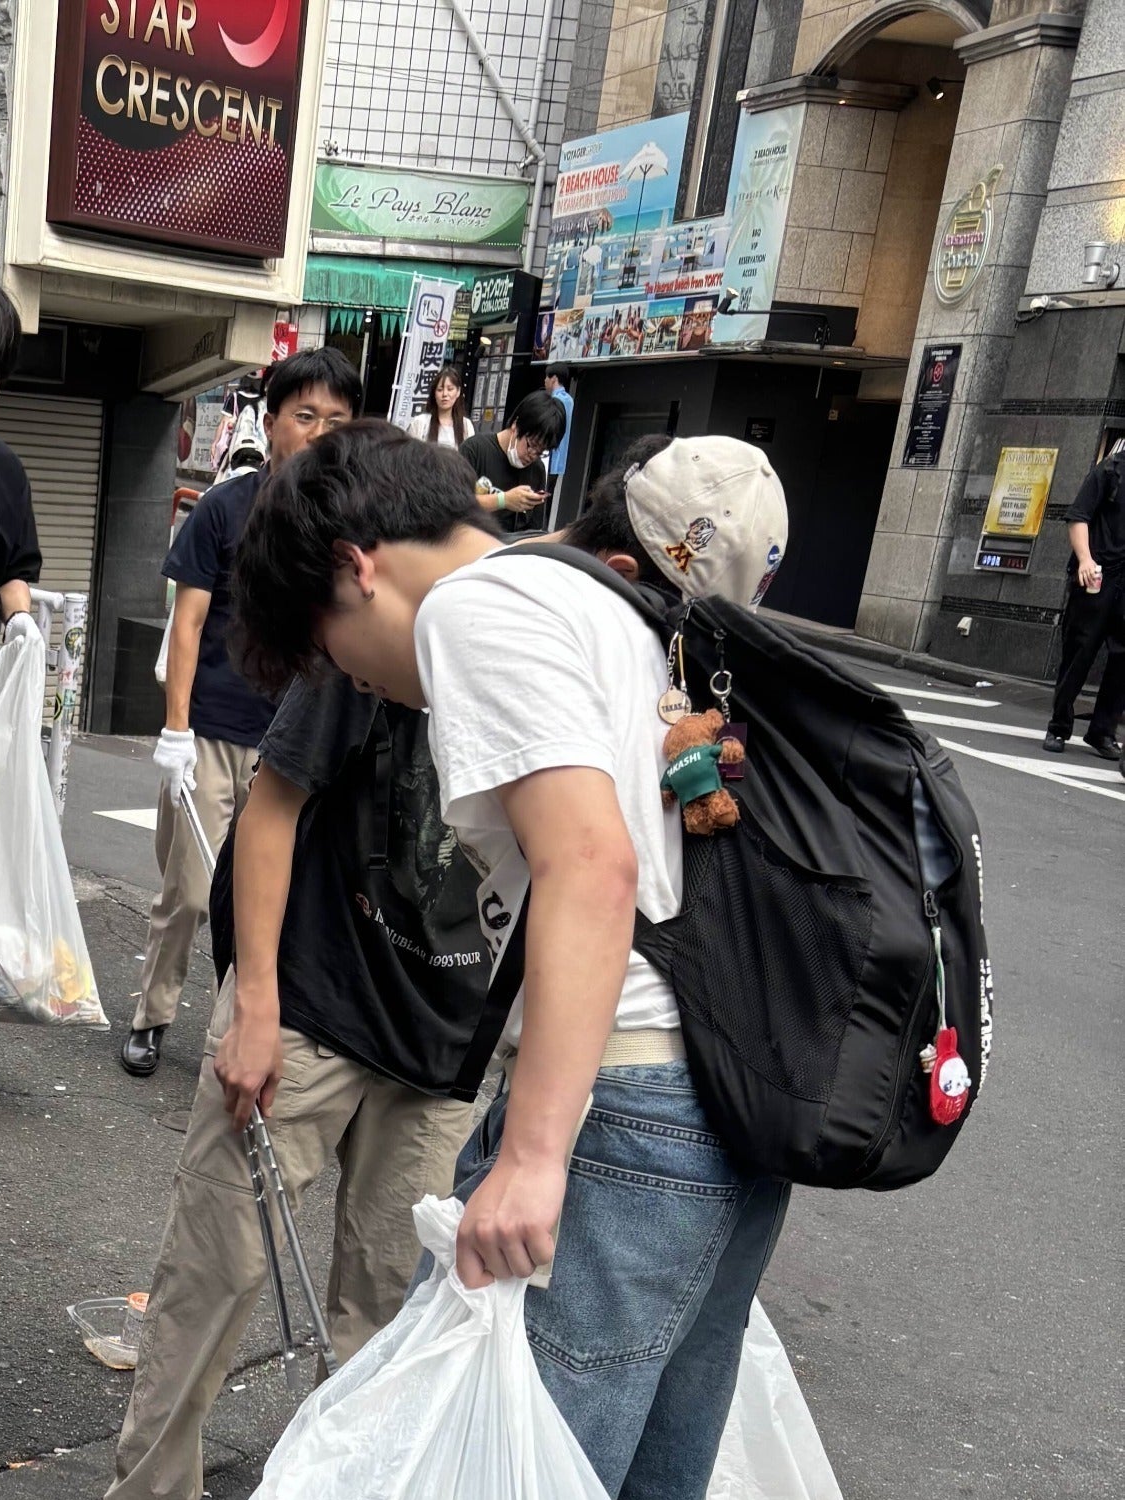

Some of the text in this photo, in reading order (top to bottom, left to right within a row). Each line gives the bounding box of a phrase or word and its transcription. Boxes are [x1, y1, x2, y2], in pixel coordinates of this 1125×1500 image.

[100, 0, 195, 56] STAR
[95, 54, 283, 151] CRESCENT
[559, 164, 620, 194] 2 BEACH HOUSE
[367, 187, 420, 222] Pays
[427, 191, 492, 218] Blanc
[738, 253, 767, 266] RESERVATION
[661, 702, 684, 714] TAKAS
[666, 751, 701, 778] TAKASHI
[428, 954, 454, 967] 1993
[455, 951, 481, 966] TOUR
